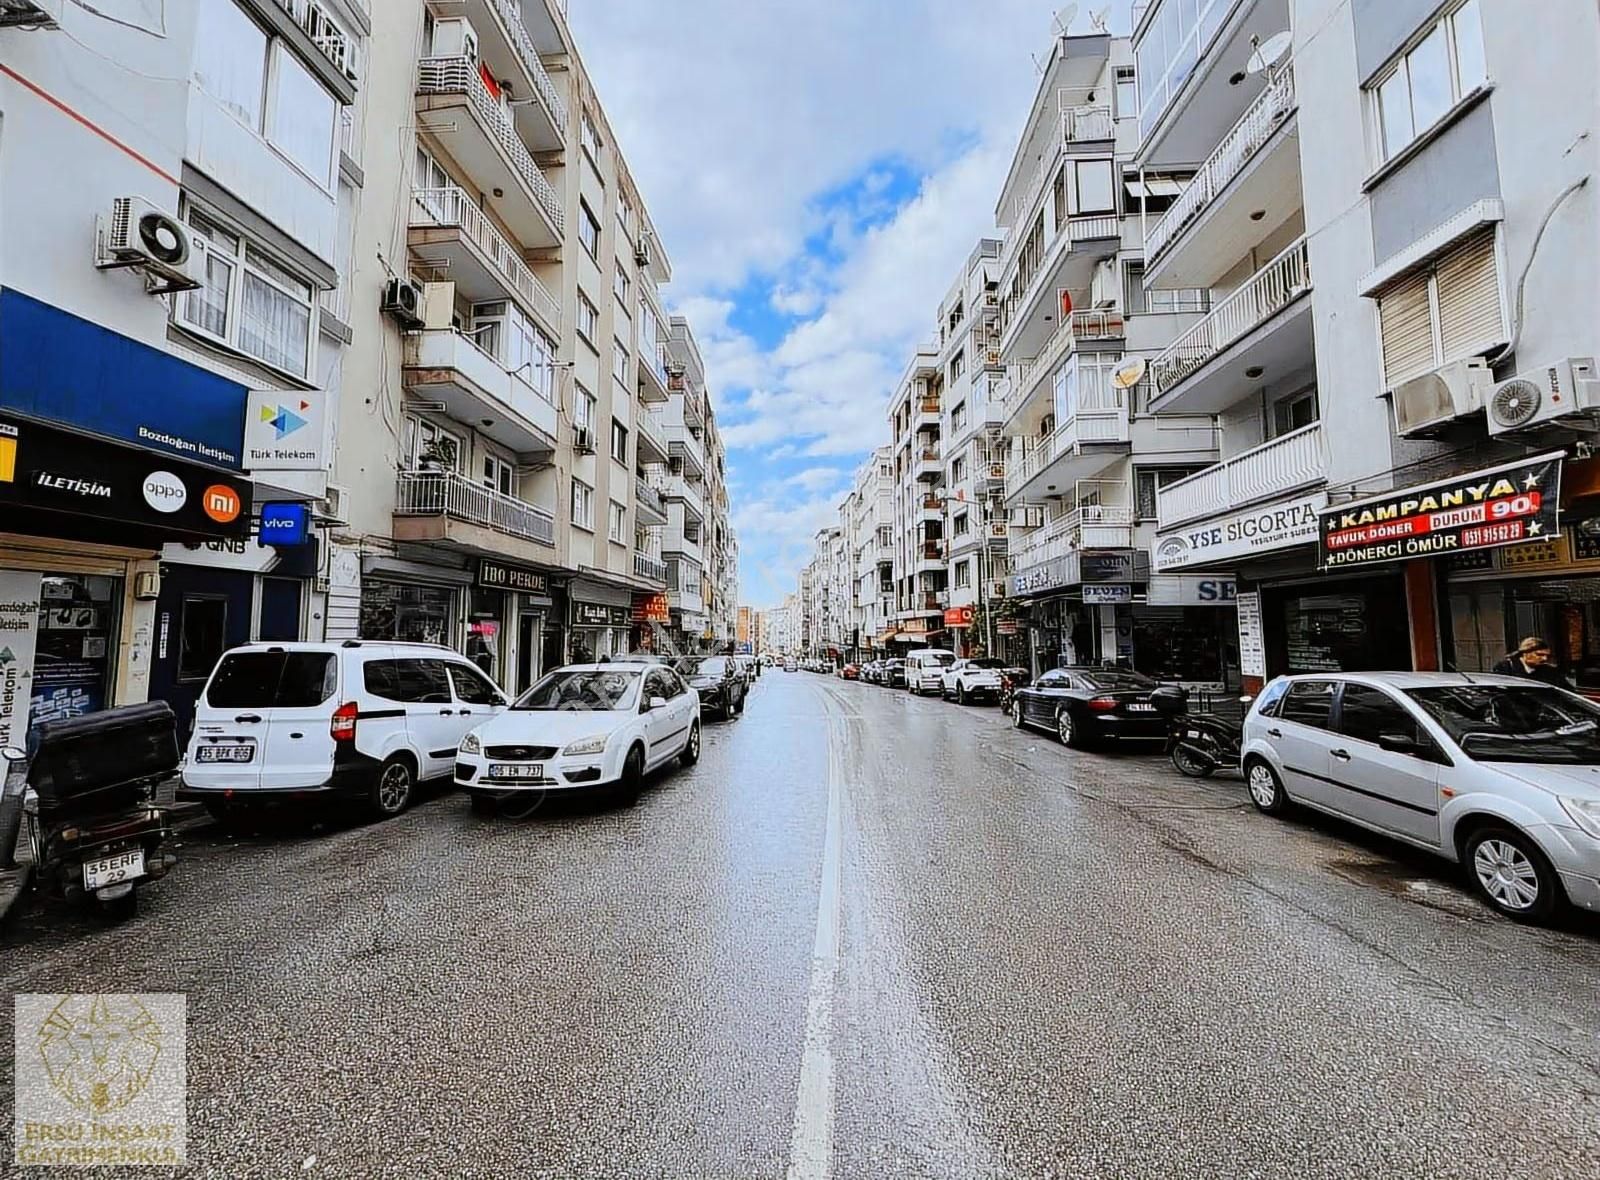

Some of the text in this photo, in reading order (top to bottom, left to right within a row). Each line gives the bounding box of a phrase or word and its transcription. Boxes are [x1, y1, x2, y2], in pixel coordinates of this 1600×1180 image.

[138, 427, 235, 463] Bozdoğan İletişim
[250, 449, 316, 460] Türk Telekom
[37, 471, 112, 498] İLETİŞİM
[146, 482, 184, 498] oppo
[1341, 478, 1515, 528] KAMPANYA
[1491, 496, 1530, 518] 90
[264, 518, 295, 528] vivo
[1188, 503, 1318, 550] YSE SİGORTA
[1329, 522, 1413, 546] TAVUK DÖNER
[1336, 534, 1457, 564] DÖNERCİ ÖMÜR
[1083, 586, 1130, 596] SEVEN
[0, 601, 36, 616] ozdoğan
[0, 617, 29, 632] letişim
[1, 667, 17, 719] Telekom
